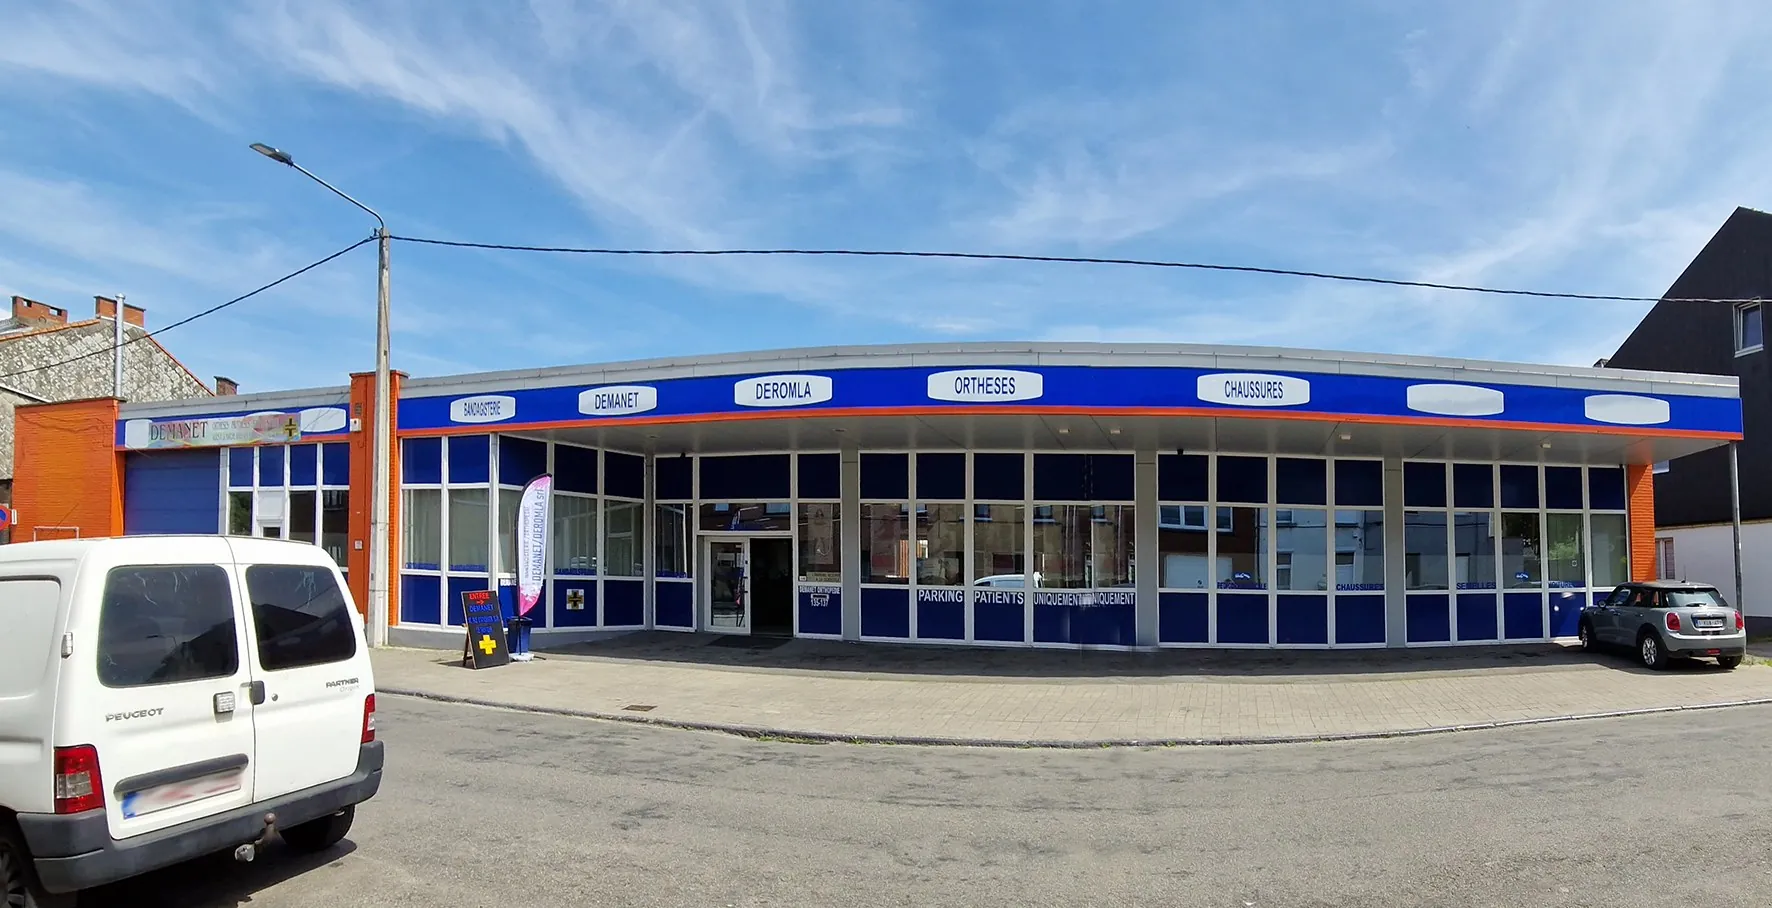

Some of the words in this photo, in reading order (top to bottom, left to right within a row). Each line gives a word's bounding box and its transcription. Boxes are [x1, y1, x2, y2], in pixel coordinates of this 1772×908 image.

[755, 381, 812, 400] DEROMLA
[955, 376, 1016, 395] ORTHESES
[1224, 380, 1284, 399] CHAUSSURES
[463, 401, 501, 416] BANDAGISTERIE
[594, 392, 639, 410] DEMANET
[150, 421, 208, 441] DEMANET
[1336, 583, 1384, 591] CHAUSSURES
[919, 590, 963, 603] PARKING
[974, 591, 1024, 605] PATIENTS
[105, 707, 164, 722] PEUGEOT
